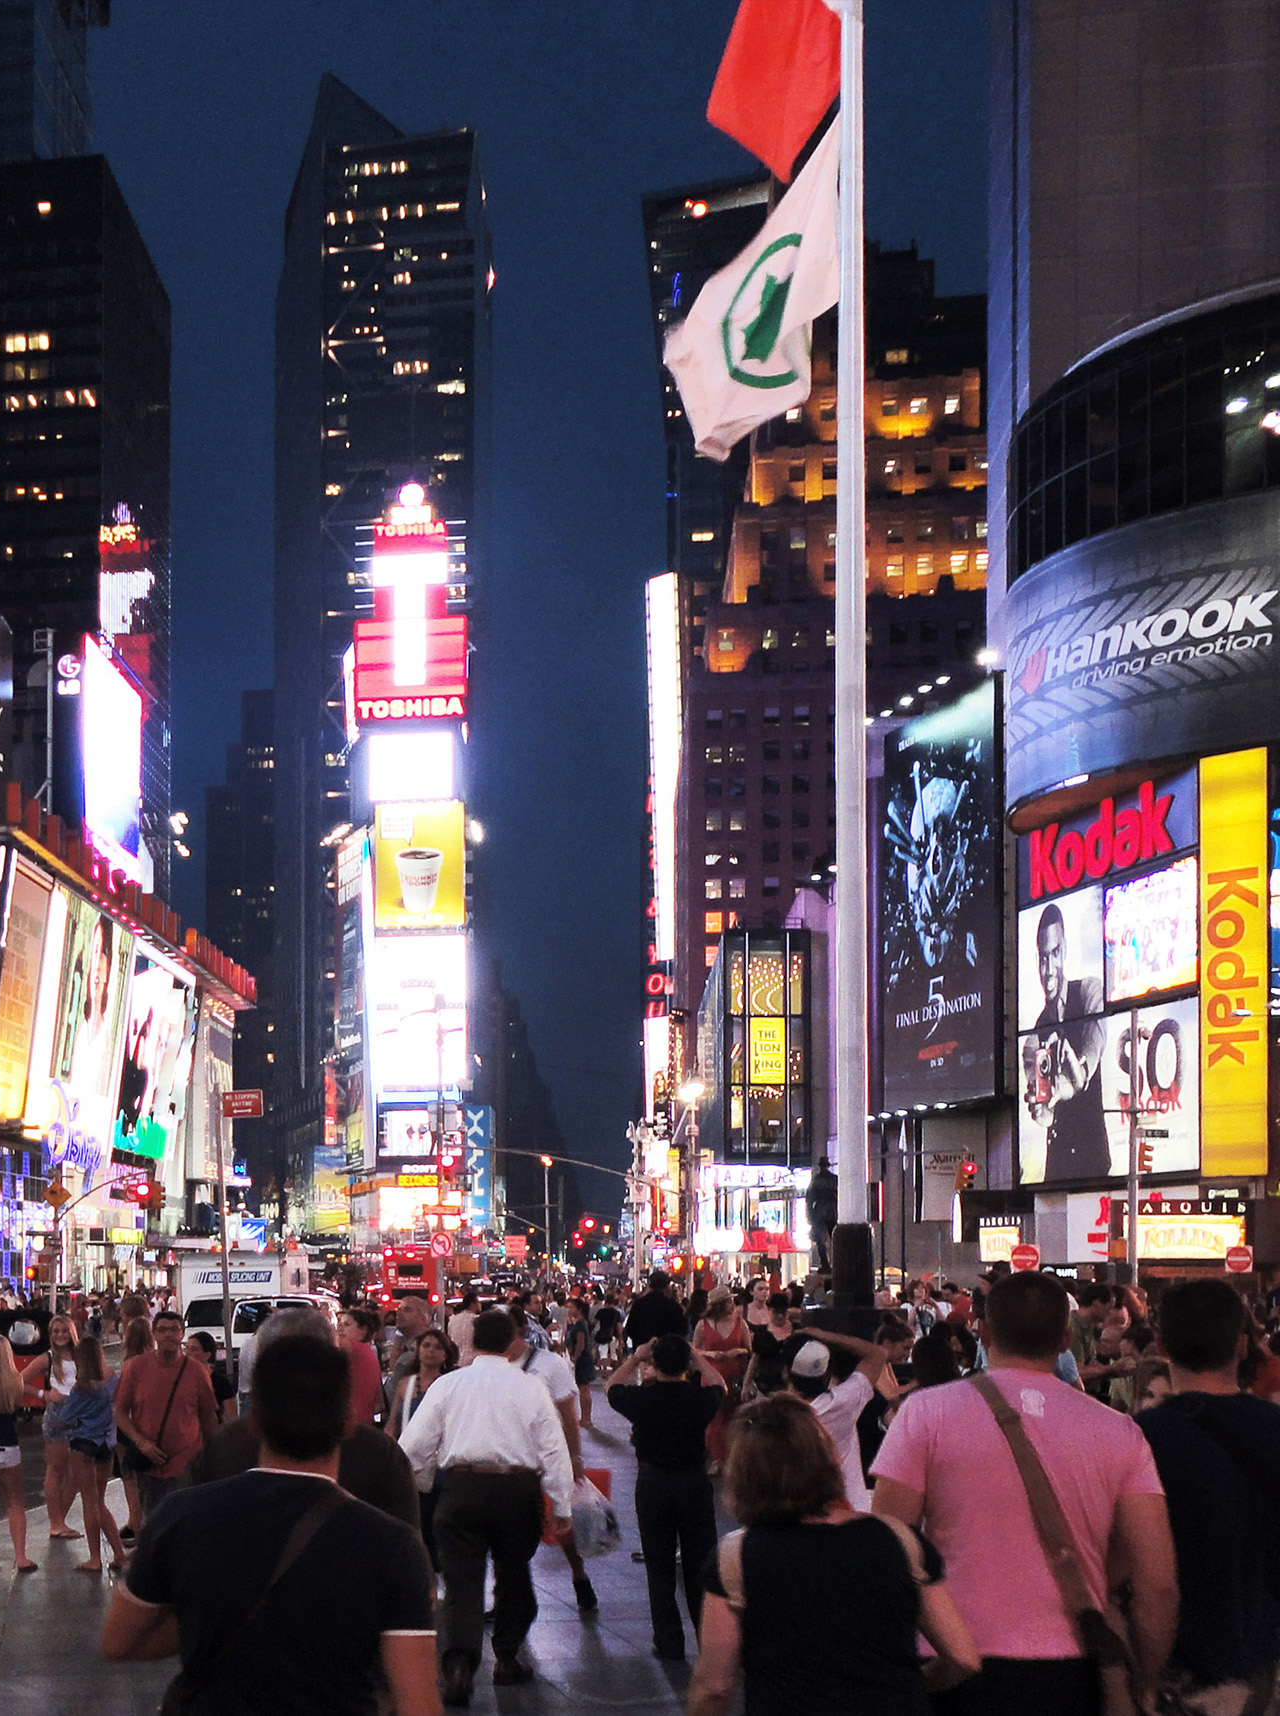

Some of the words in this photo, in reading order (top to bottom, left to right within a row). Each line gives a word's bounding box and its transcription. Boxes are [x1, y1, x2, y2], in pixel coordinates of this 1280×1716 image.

[376, 522, 445, 537] TOSHIBA
[1072, 655, 1146, 688] driving
[1150, 632, 1274, 666] emotion
[358, 697, 465, 719] TOSHIBA
[1029, 780, 1175, 899] Kodak
[1206, 866, 1260, 1069] Kodak
[895, 1010, 920, 1028] FINAL
[922, 992, 982, 1022] DESTINATION
[758, 1030, 777, 1038] THE
[754, 1042, 781, 1056] LION
[754, 1059, 782, 1074] KING
[930, 1153, 975, 1165] Marrtt
[402, 1164, 438, 1174] SONY
[1123, 1202, 1247, 1213] MARQUIS
[979, 1216, 1021, 1226] MARQUIS
[1143, 1228, 1225, 1256] FOLLIES
